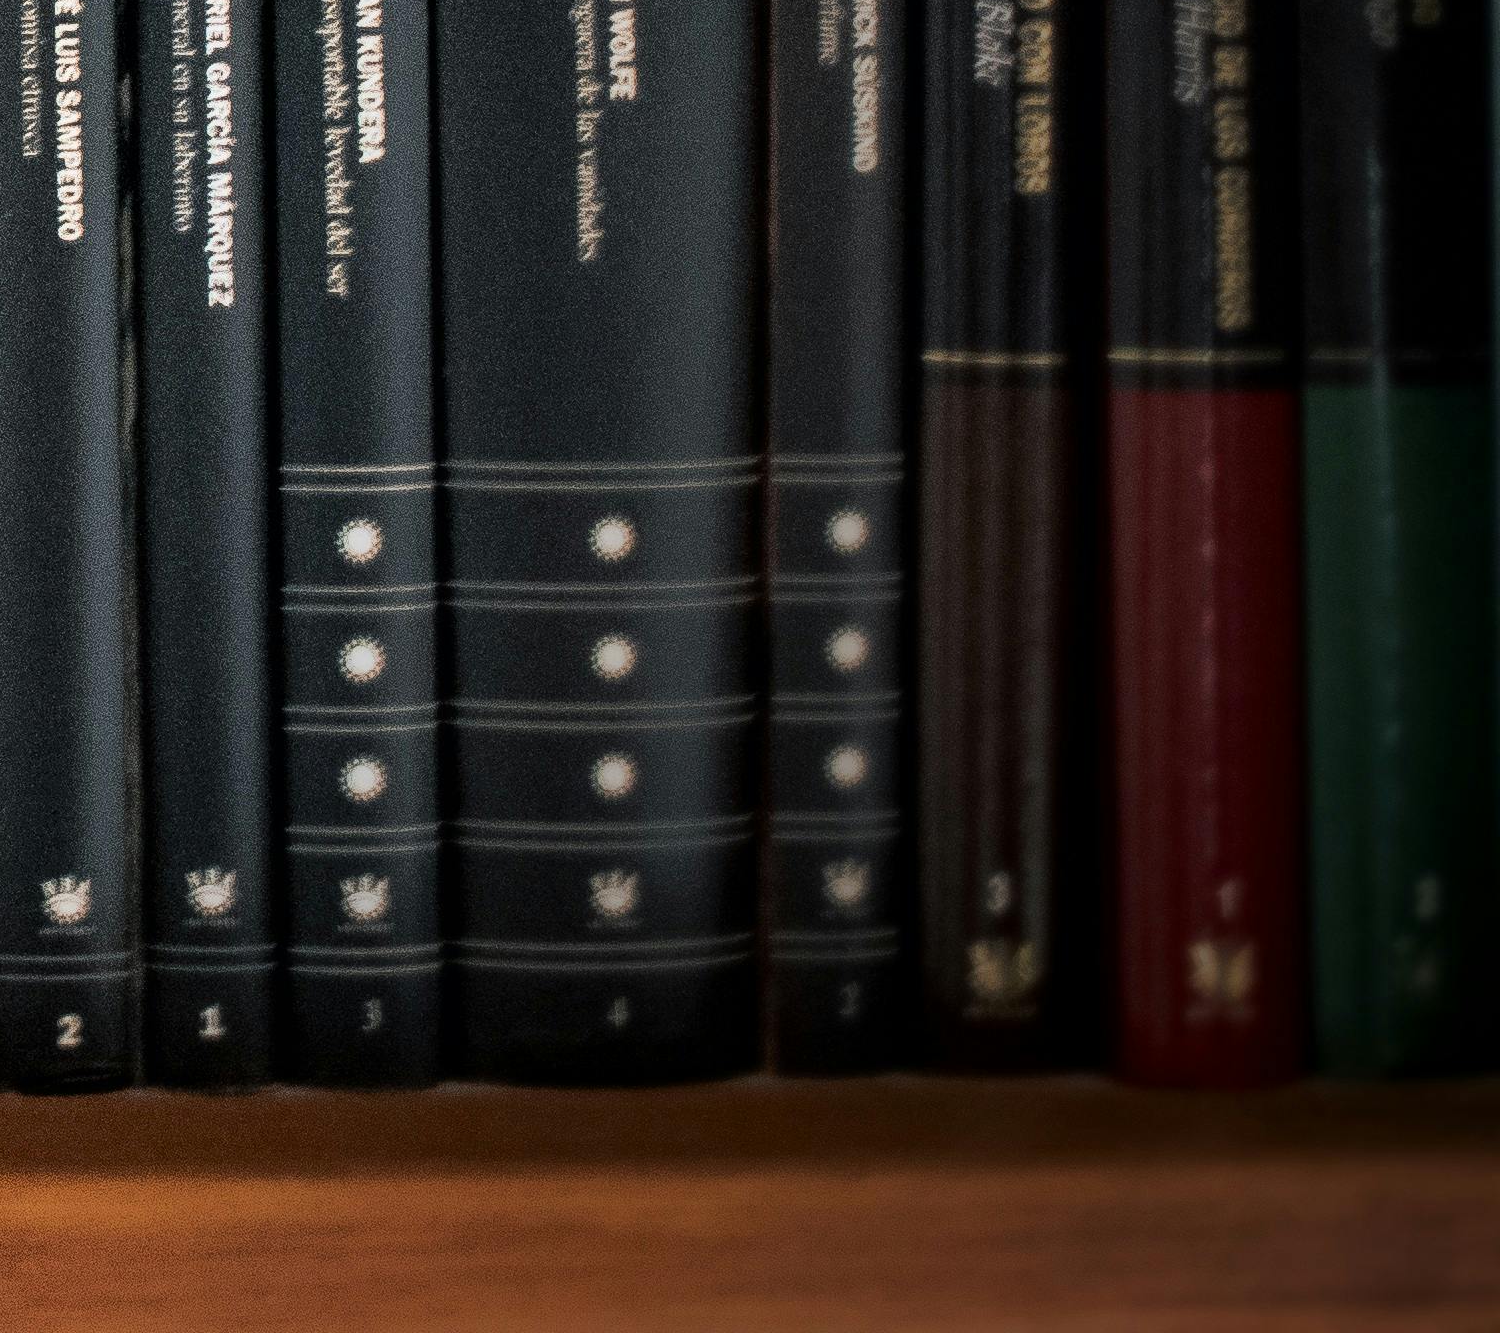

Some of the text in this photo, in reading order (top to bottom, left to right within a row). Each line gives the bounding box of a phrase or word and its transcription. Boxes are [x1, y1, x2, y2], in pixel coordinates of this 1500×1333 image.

[55, 23, 81, 83] LUIS
[357, 35, 385, 163] KUNDERA
[609, 8, 636, 99] WOLFE
[56, 90, 84, 241] SAMPEDRO
[206, 62, 235, 165] GARCÍA
[205, 172, 235, 306] MÁRQUEZ
